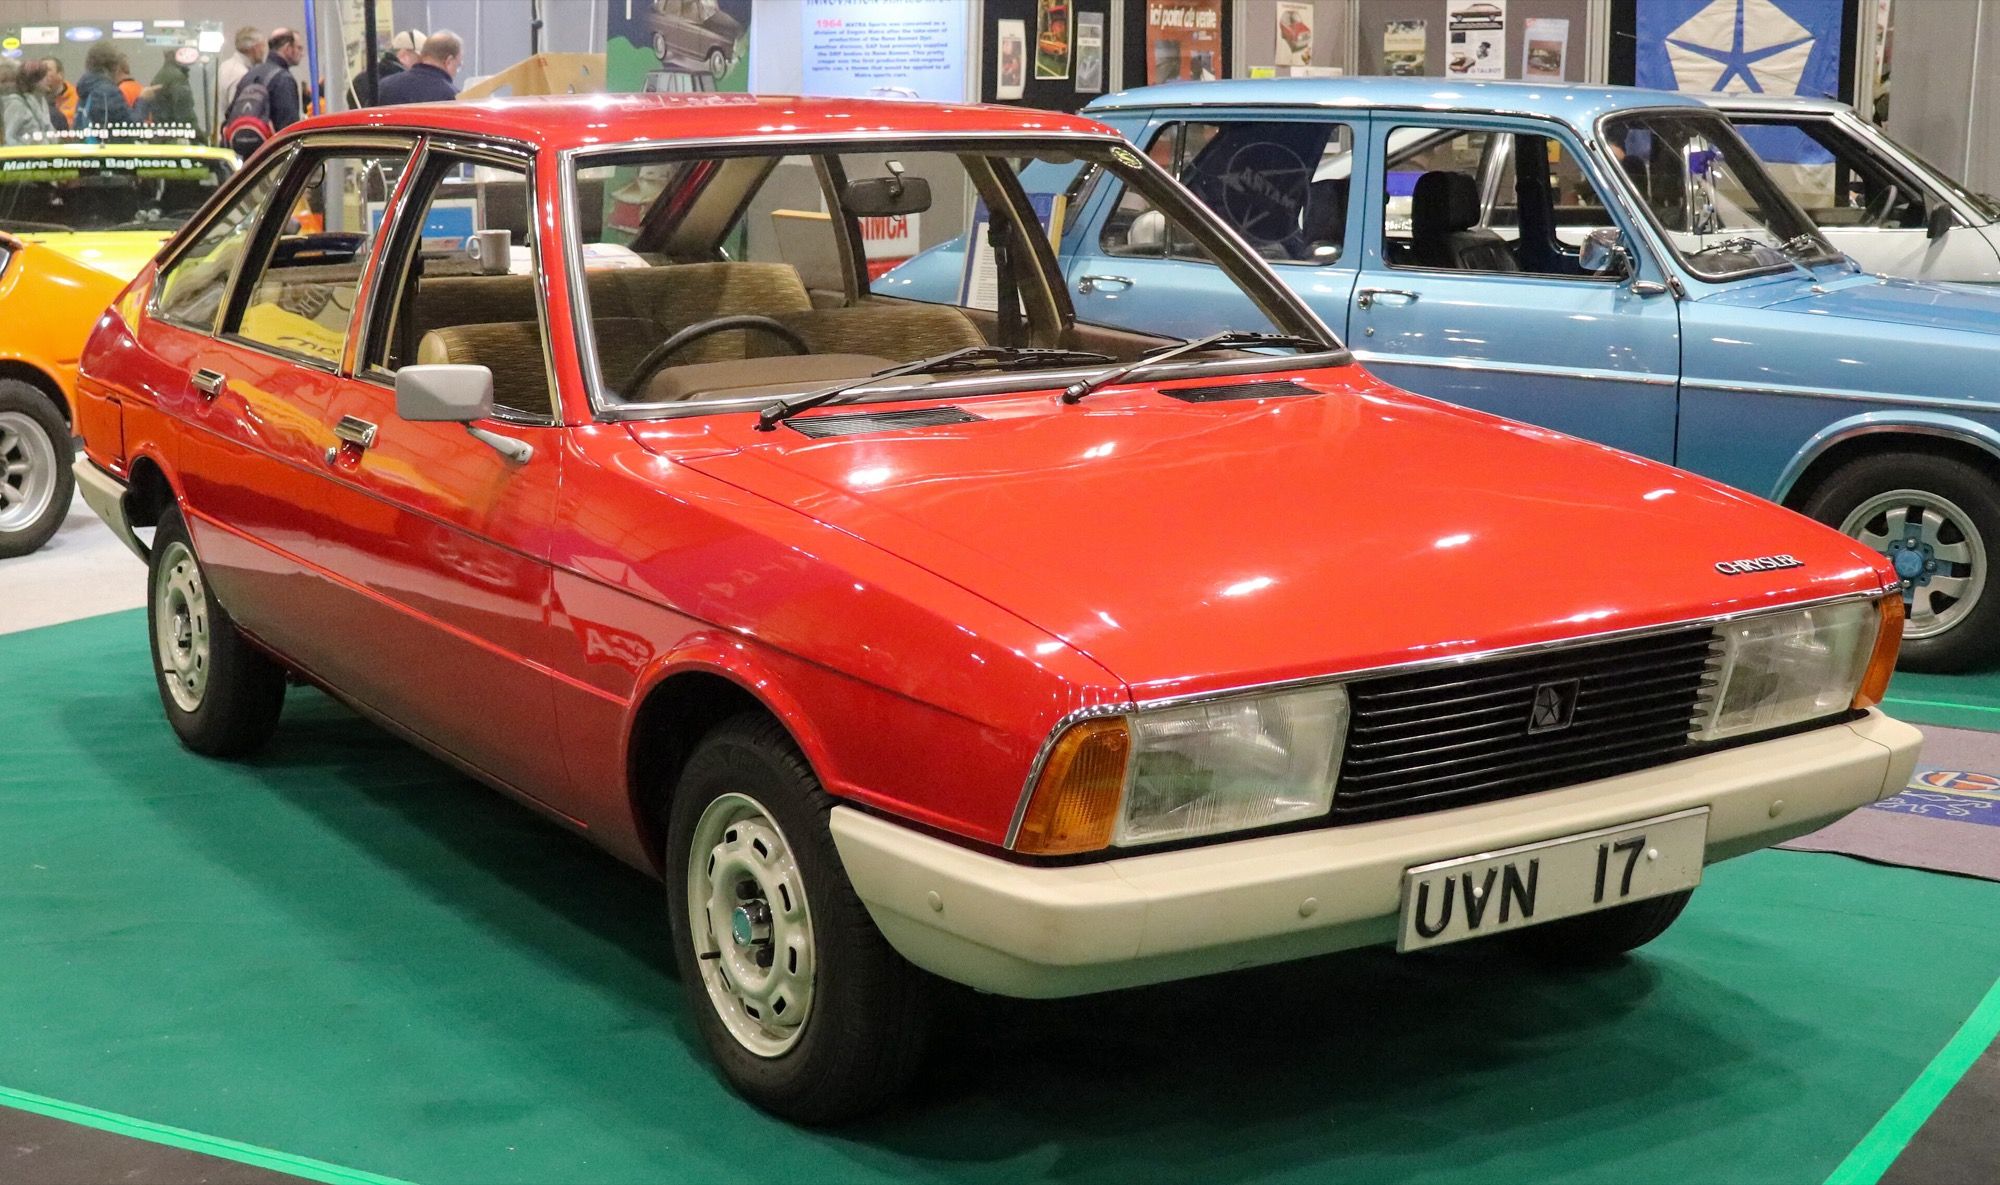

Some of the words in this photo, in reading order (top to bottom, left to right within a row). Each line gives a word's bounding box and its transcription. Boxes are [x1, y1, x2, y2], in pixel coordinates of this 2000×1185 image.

[816, 19, 842, 28] 1964
[1160, 6, 1185, 30] point
[46, 127, 109, 139] Bagheera
[112, 127, 196, 139] Matra-Simca
[3, 157, 101, 172] Matra-Simca
[105, 157, 177, 170] Bagheera
[857, 214, 909, 241] IMCA
[1715, 554, 1804, 575] CHRYSLER
[1415, 857, 1540, 939] UVN
